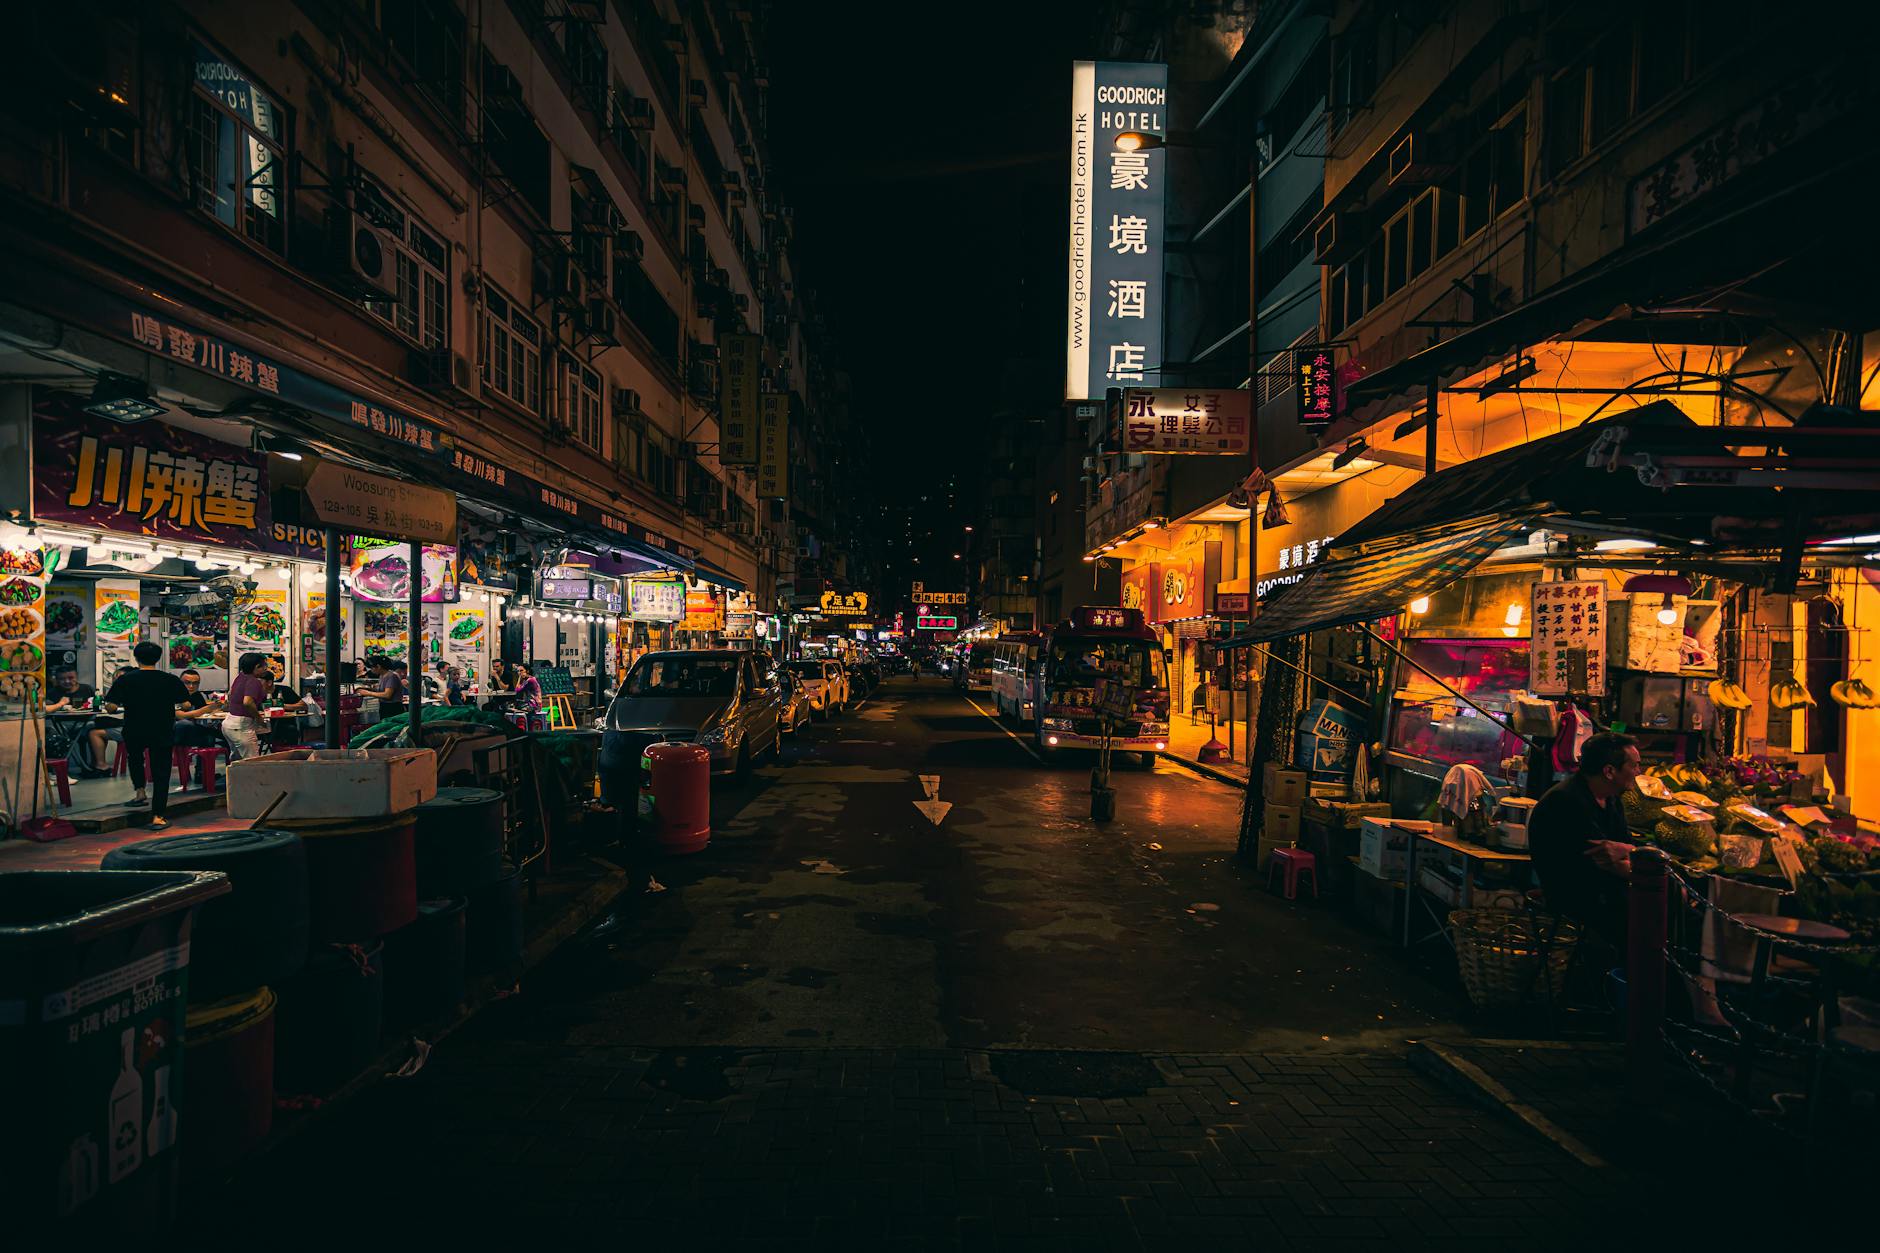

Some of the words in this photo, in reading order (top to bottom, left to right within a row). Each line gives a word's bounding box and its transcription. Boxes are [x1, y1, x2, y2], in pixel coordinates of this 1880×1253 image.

[1098, 86, 1166, 105] GOODRICH
[1101, 111, 1161, 131] HOTEL
[1073, 112, 1087, 349] www.goodrichhotel.com.hk
[1106, 150, 1150, 382] 豪境酒店
[131, 311, 279, 395] 鳴發川辣蟹
[1183, 393, 1221, 413] 女子
[1313, 353, 1331, 411] 永安按摩
[351, 400, 434, 451] 鳴發川辣蟹
[1128, 390, 1155, 449] 永安
[1160, 415, 1245, 435] 理髮公司
[68, 435, 260, 534] 川辣蟹
[343, 473, 397, 503] Woosung
[367, 505, 413, 531] 吳松街
